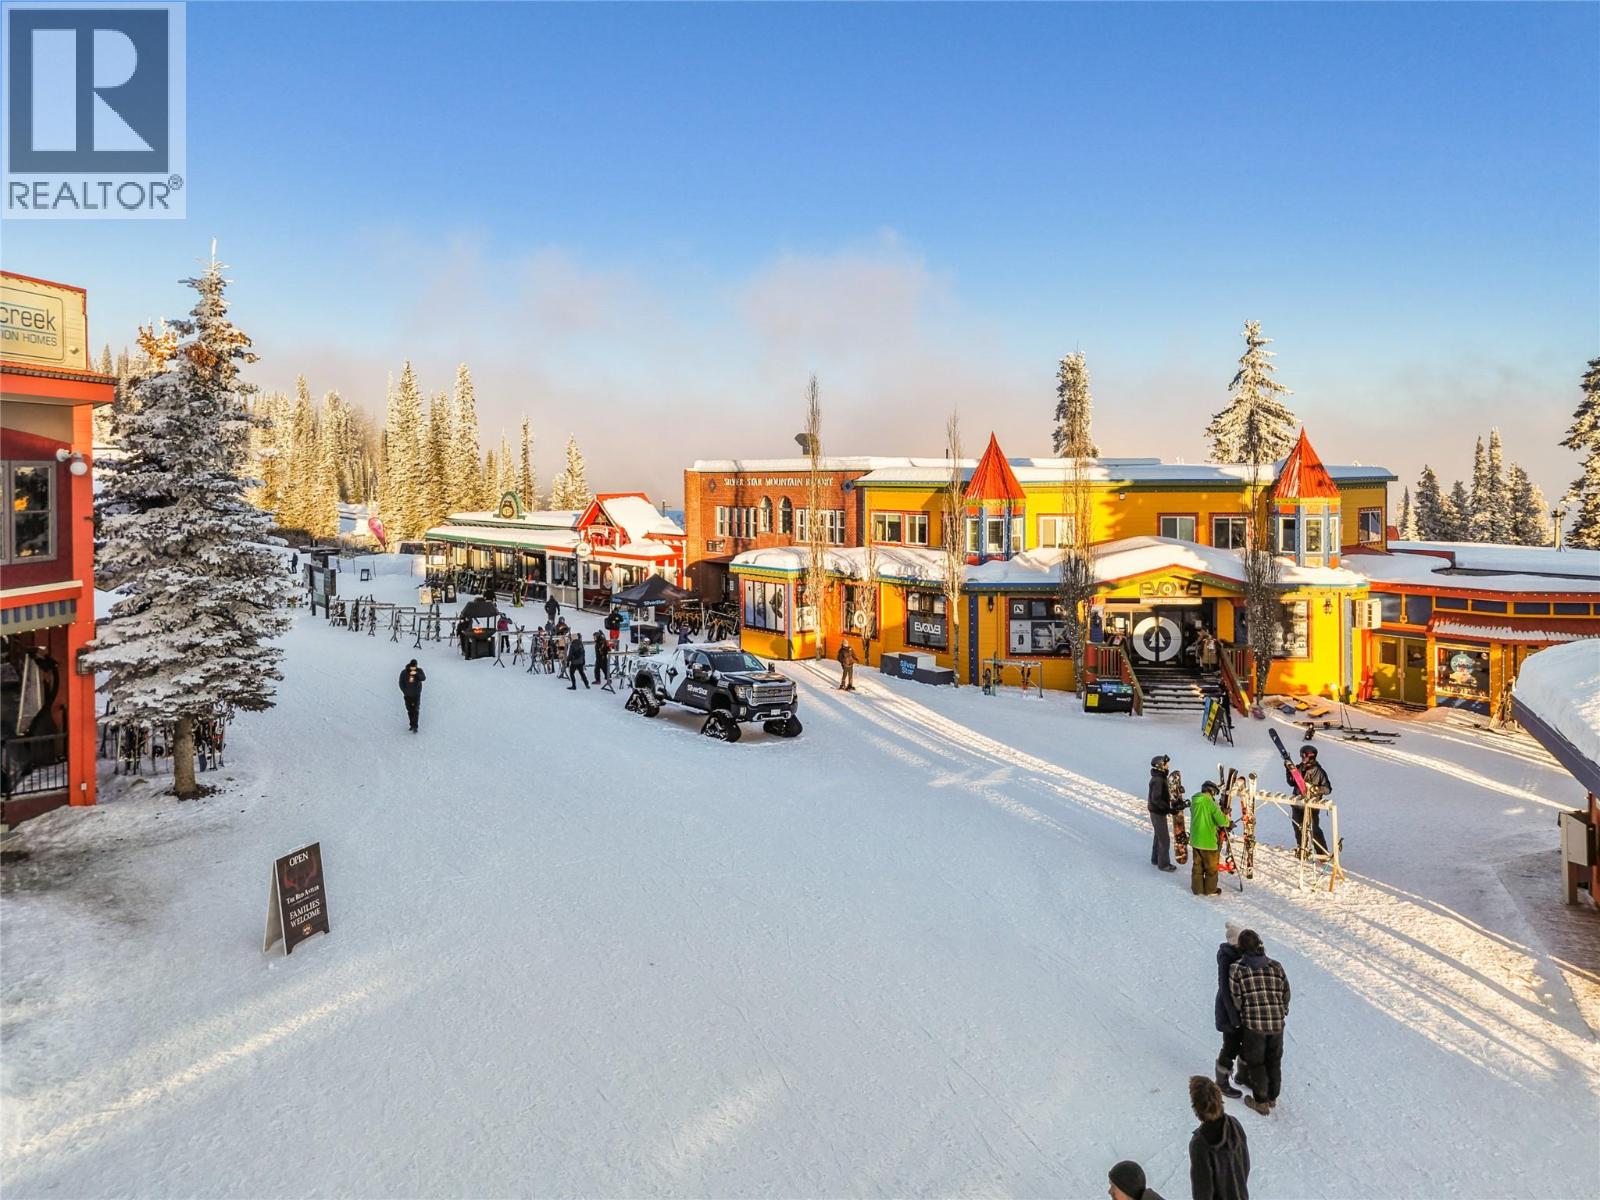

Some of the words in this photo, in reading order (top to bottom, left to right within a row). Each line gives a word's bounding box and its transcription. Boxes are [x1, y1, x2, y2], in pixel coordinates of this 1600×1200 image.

[0, 306, 56, 331] creek
[22, 332, 57, 347] HOMES
[724, 478, 744, 486] SILVER
[746, 478, 762, 486] STAR
[765, 477, 803, 486] MOUNTAIN
[914, 621, 941, 635] EVOLVE
[289, 851, 309, 867] OPEN
[289, 898, 320, 920] FAMILIES
[290, 907, 321, 928] WELCOME
